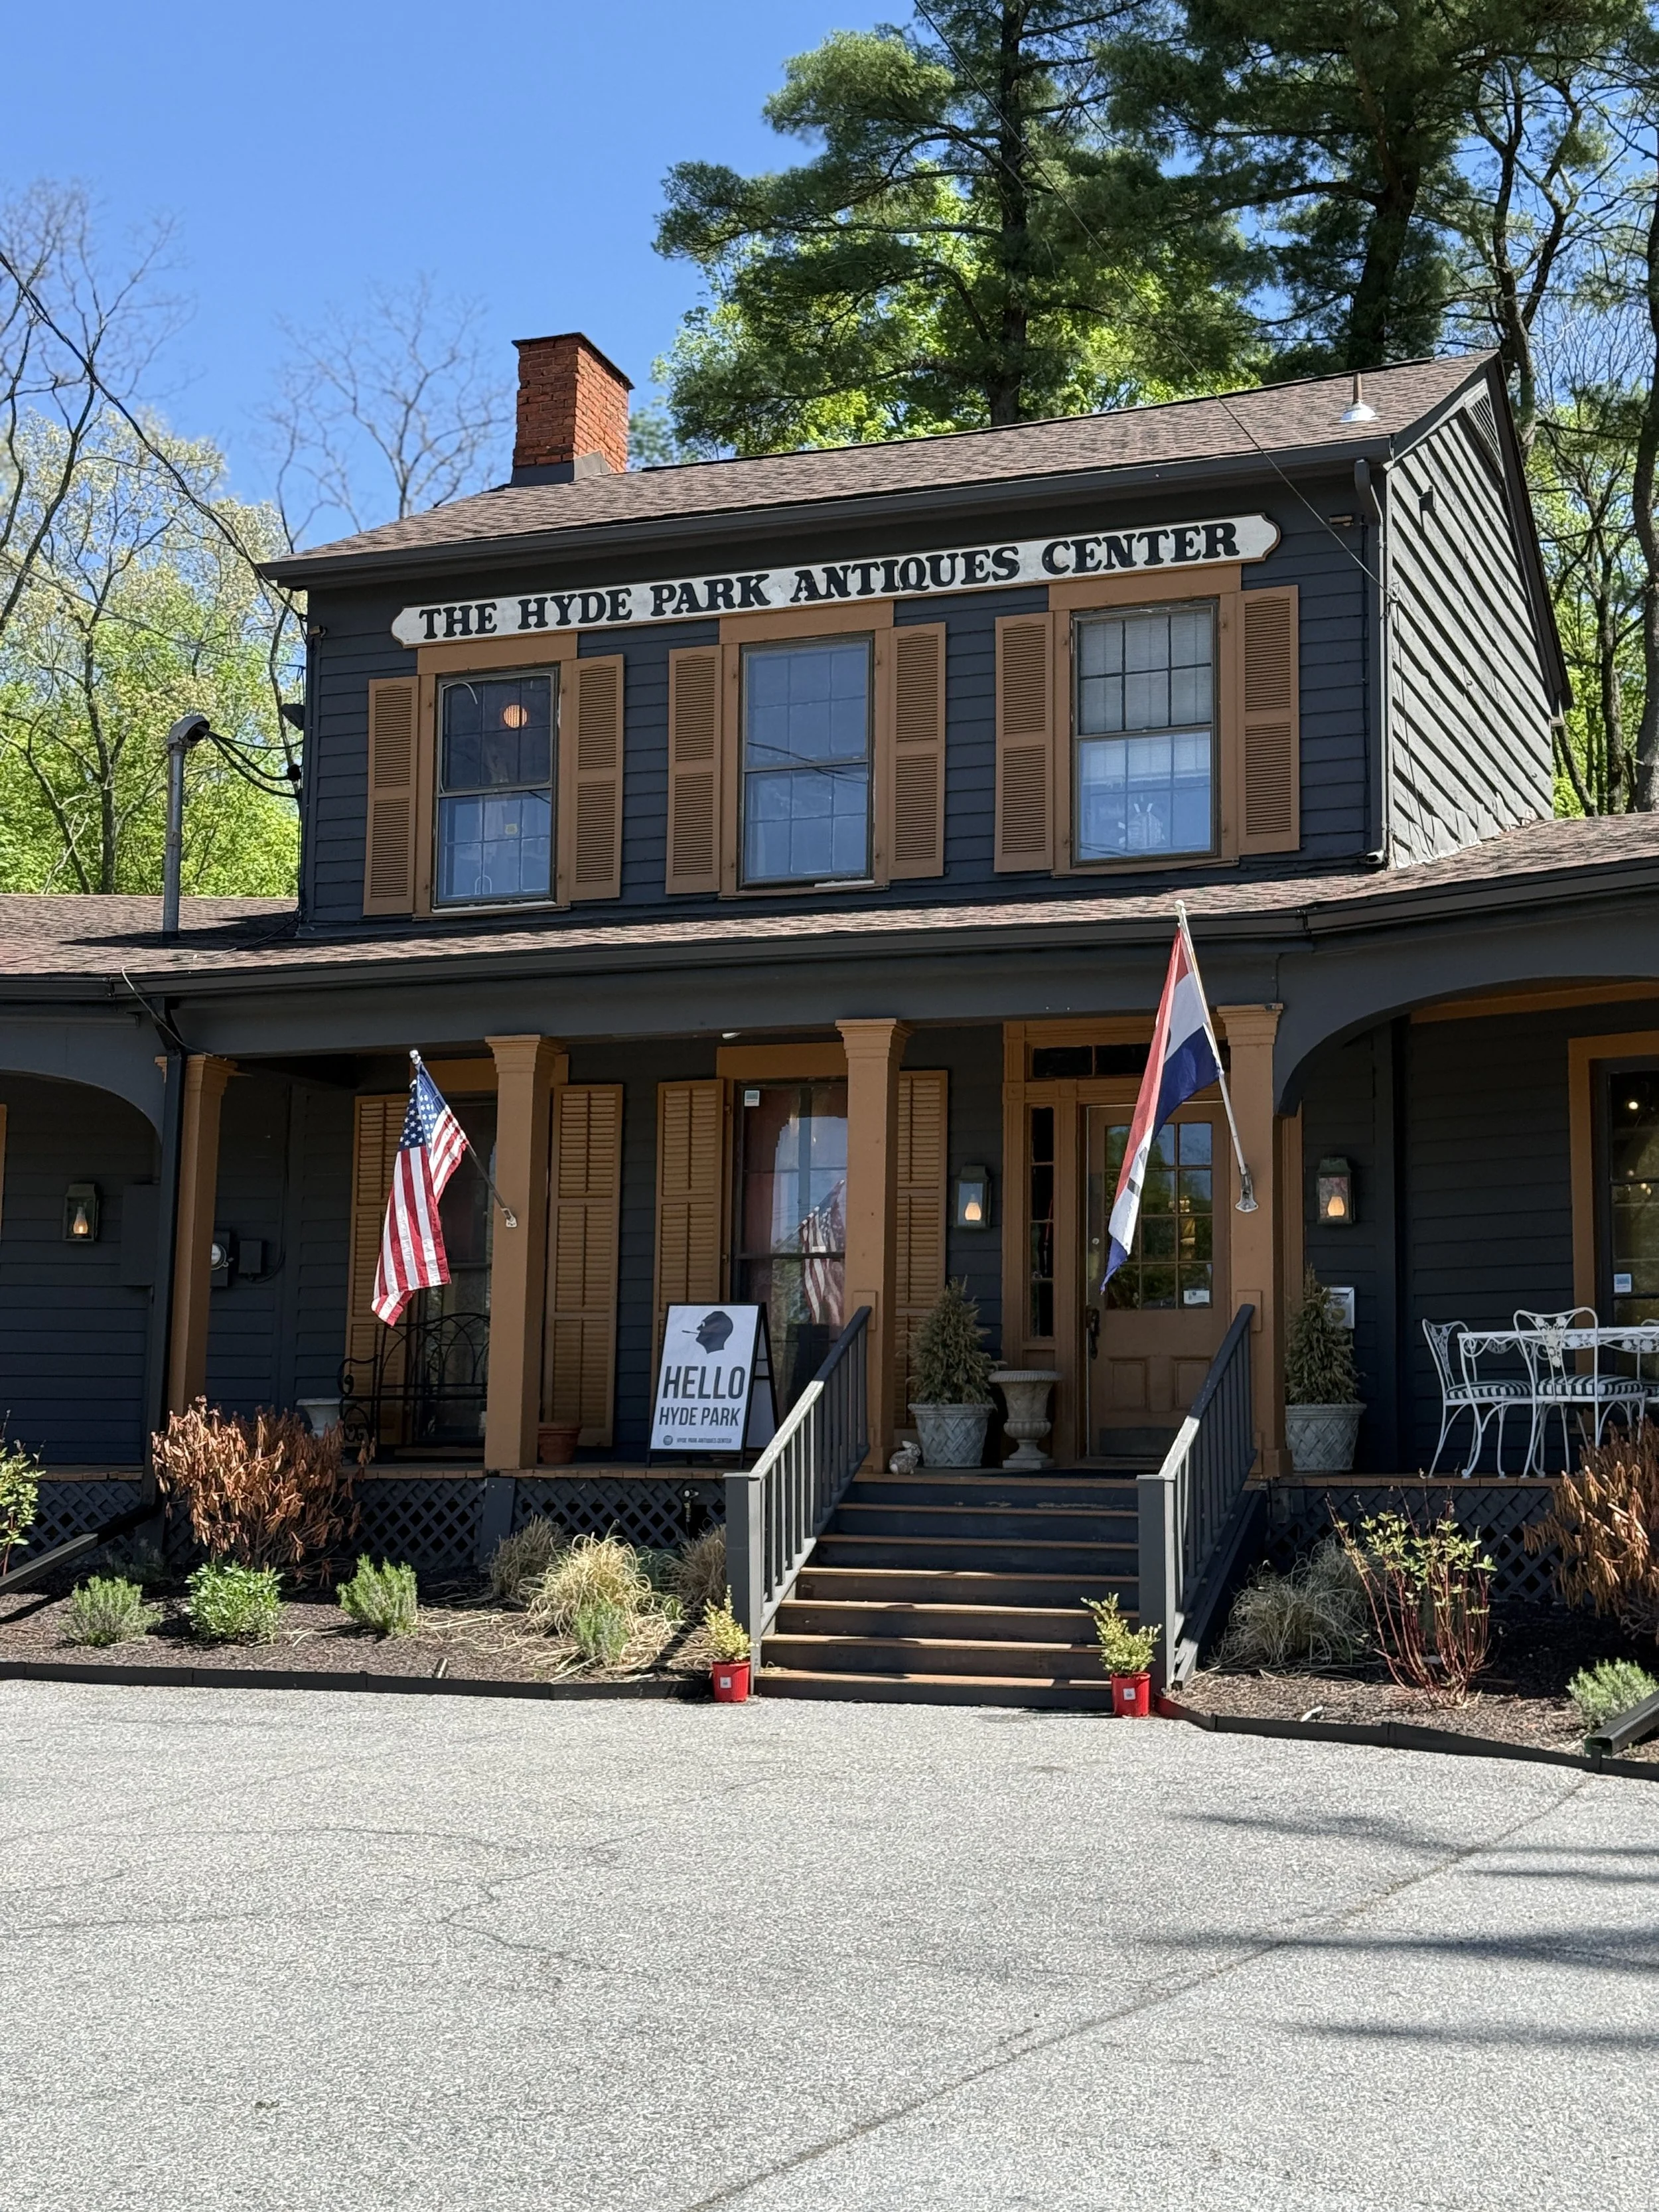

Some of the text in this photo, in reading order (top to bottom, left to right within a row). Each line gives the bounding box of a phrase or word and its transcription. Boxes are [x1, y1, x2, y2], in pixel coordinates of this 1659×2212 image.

[419, 522, 1240, 640] THE HYDE PARK ANTIQUES CENTER
[662, 1365, 746, 1400] HELLO
[659, 1406, 742, 1427] HYDE PARK
